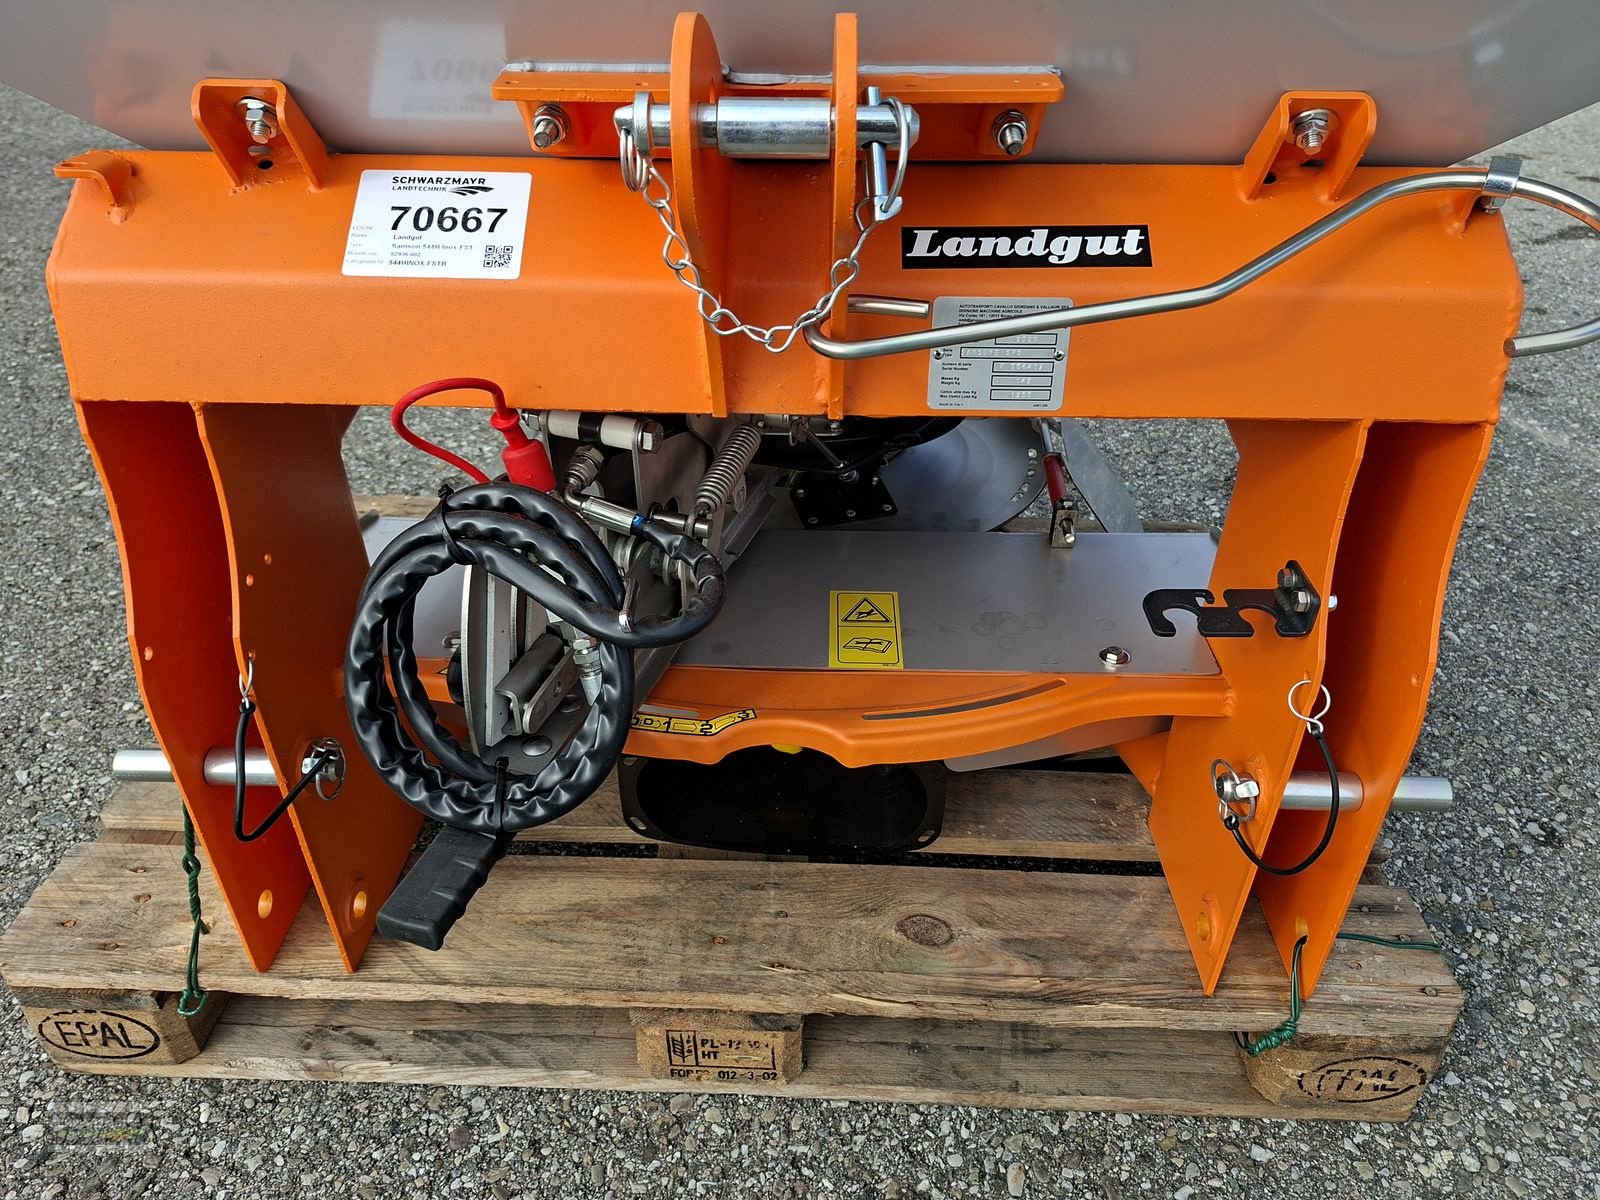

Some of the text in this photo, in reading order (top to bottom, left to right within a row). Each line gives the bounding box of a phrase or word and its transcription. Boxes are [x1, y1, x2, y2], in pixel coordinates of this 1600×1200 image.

[392, 176, 486, 185] SCHWARZMAYR
[390, 206, 508, 233] 70667
[905, 229, 1146, 264] Landgut
[700, 723, 714, 733] 2
[54, 1021, 147, 1049] EPAL
[702, 1051, 720, 1060] HT
